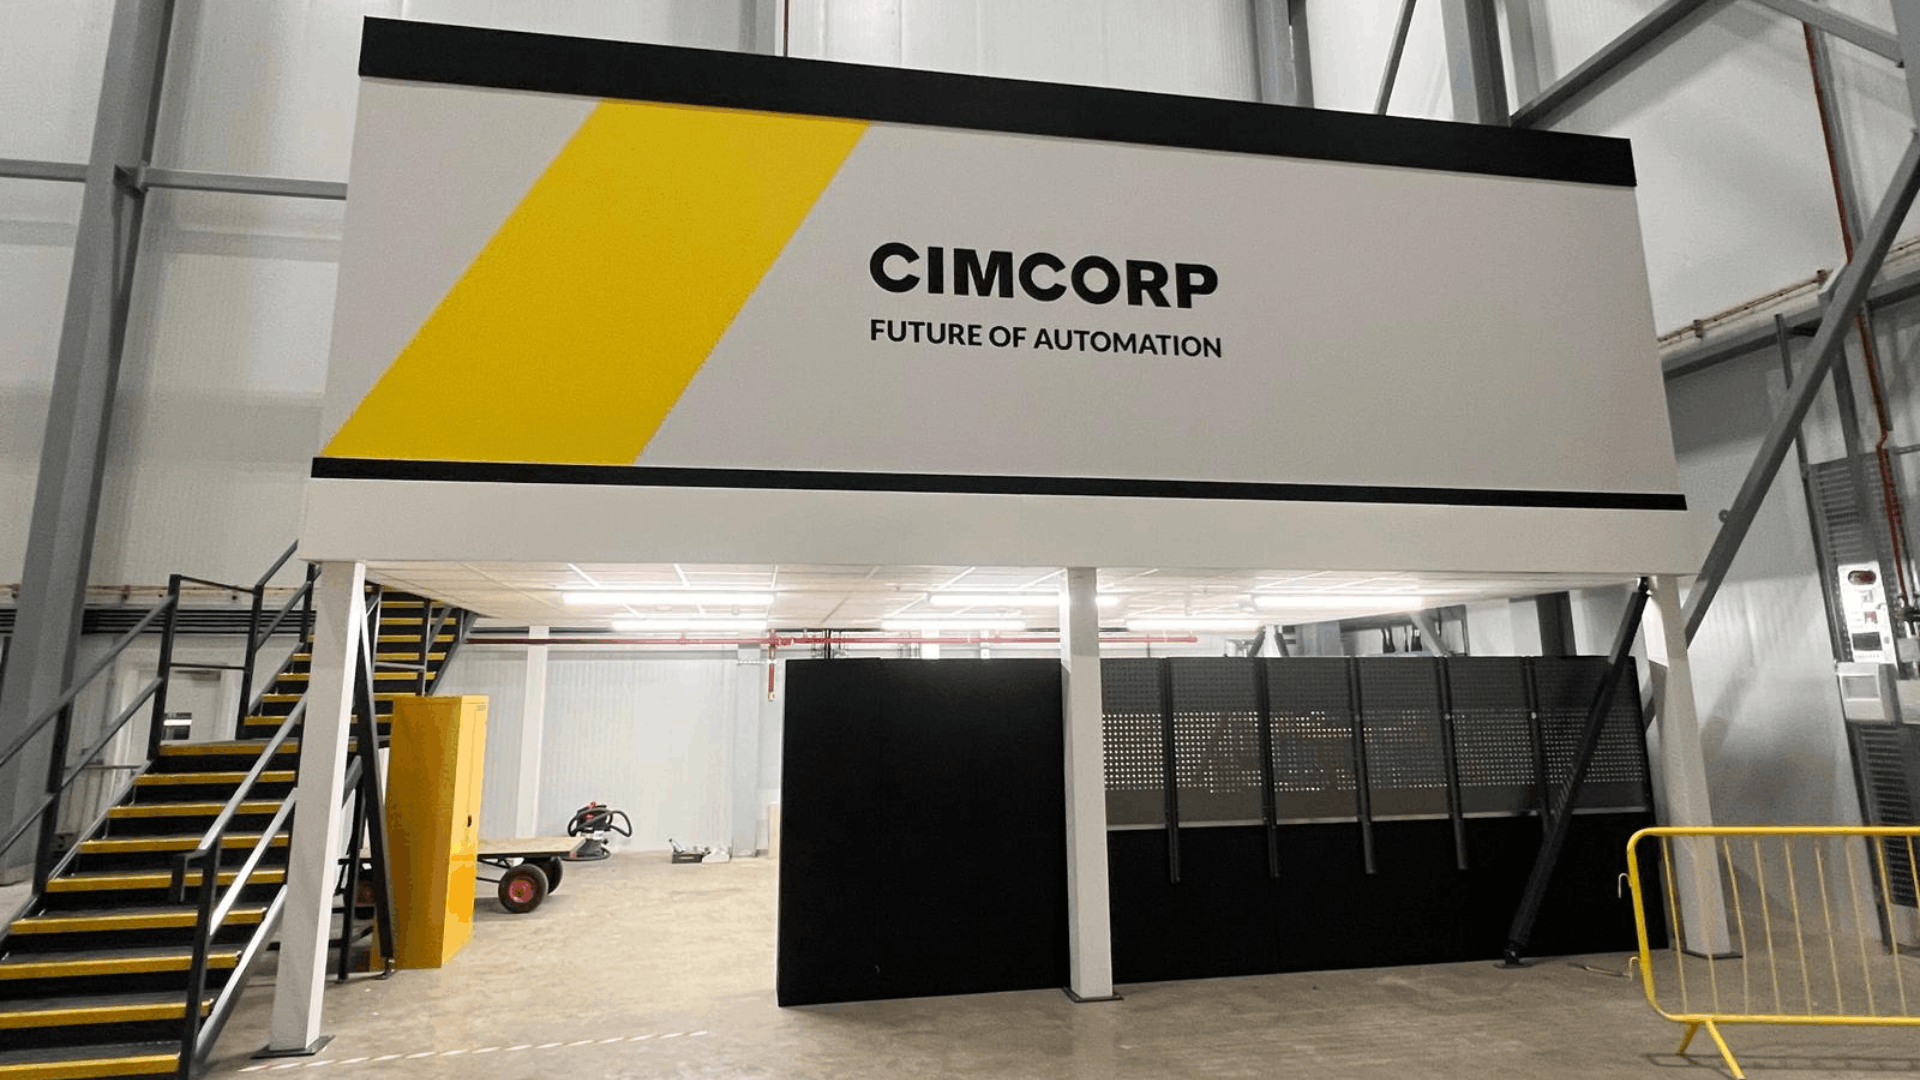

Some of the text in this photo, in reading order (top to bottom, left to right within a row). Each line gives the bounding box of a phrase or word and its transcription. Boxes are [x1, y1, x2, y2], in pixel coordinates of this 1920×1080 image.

[869, 242, 1219, 309] CIMCORP
[870, 319, 1222, 359] FUTURE OF AUTOMATION
